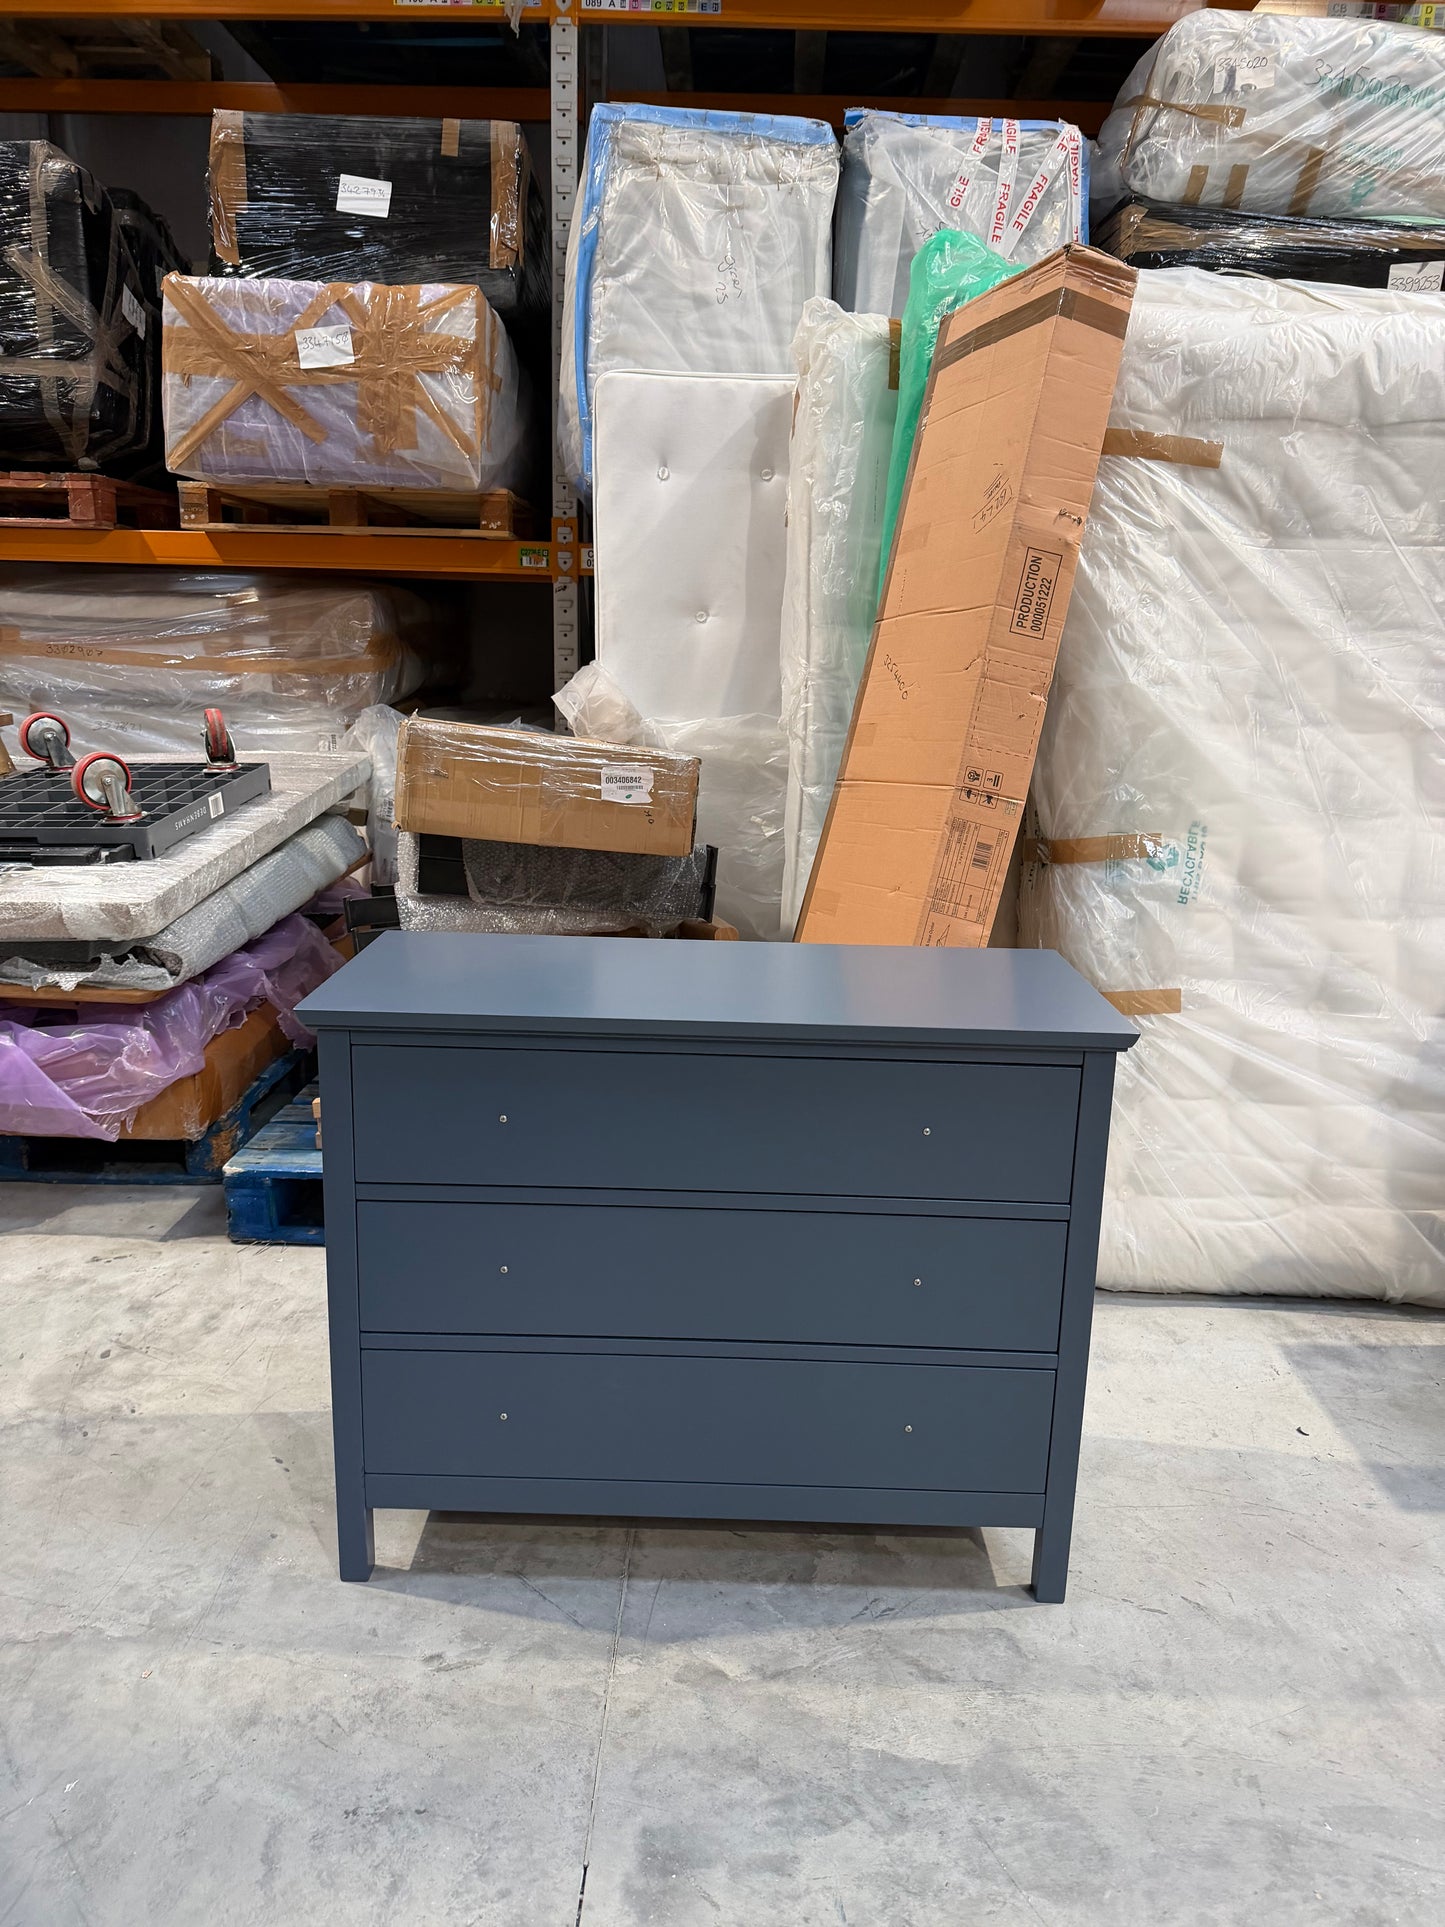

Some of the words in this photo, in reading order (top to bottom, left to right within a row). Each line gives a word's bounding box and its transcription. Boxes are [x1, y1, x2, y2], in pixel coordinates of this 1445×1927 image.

[991, 182, 1011, 244] FRAGILE
[1012, 173, 1048, 232] FRAGILE
[1016, 555, 1043, 629] PRODUCTION
[1030, 577, 1052, 632] 000051222
[605, 776, 642, 785] 003406842
